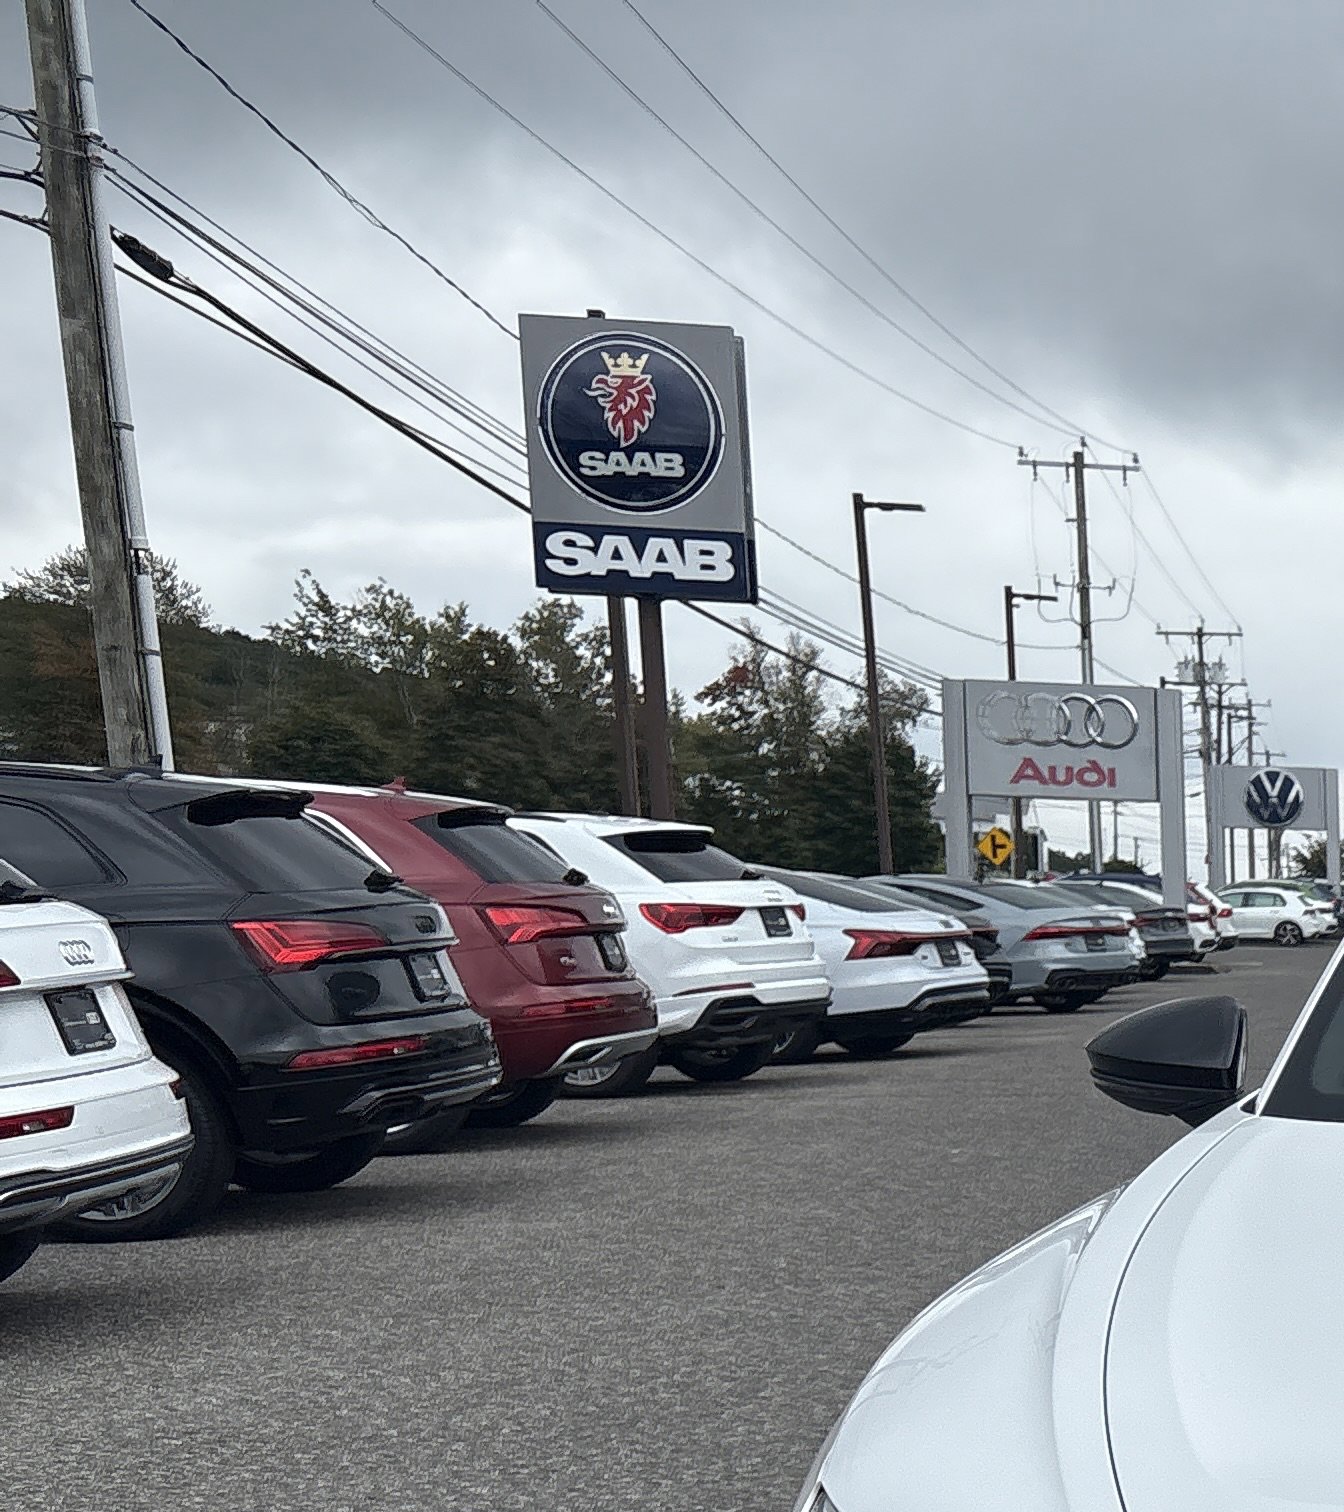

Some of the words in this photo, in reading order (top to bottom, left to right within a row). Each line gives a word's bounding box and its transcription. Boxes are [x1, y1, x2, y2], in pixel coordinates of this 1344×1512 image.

[579, 451, 686, 478] SAAB
[545, 531, 735, 582] SAAB
[1009, 757, 1117, 788] Audi
